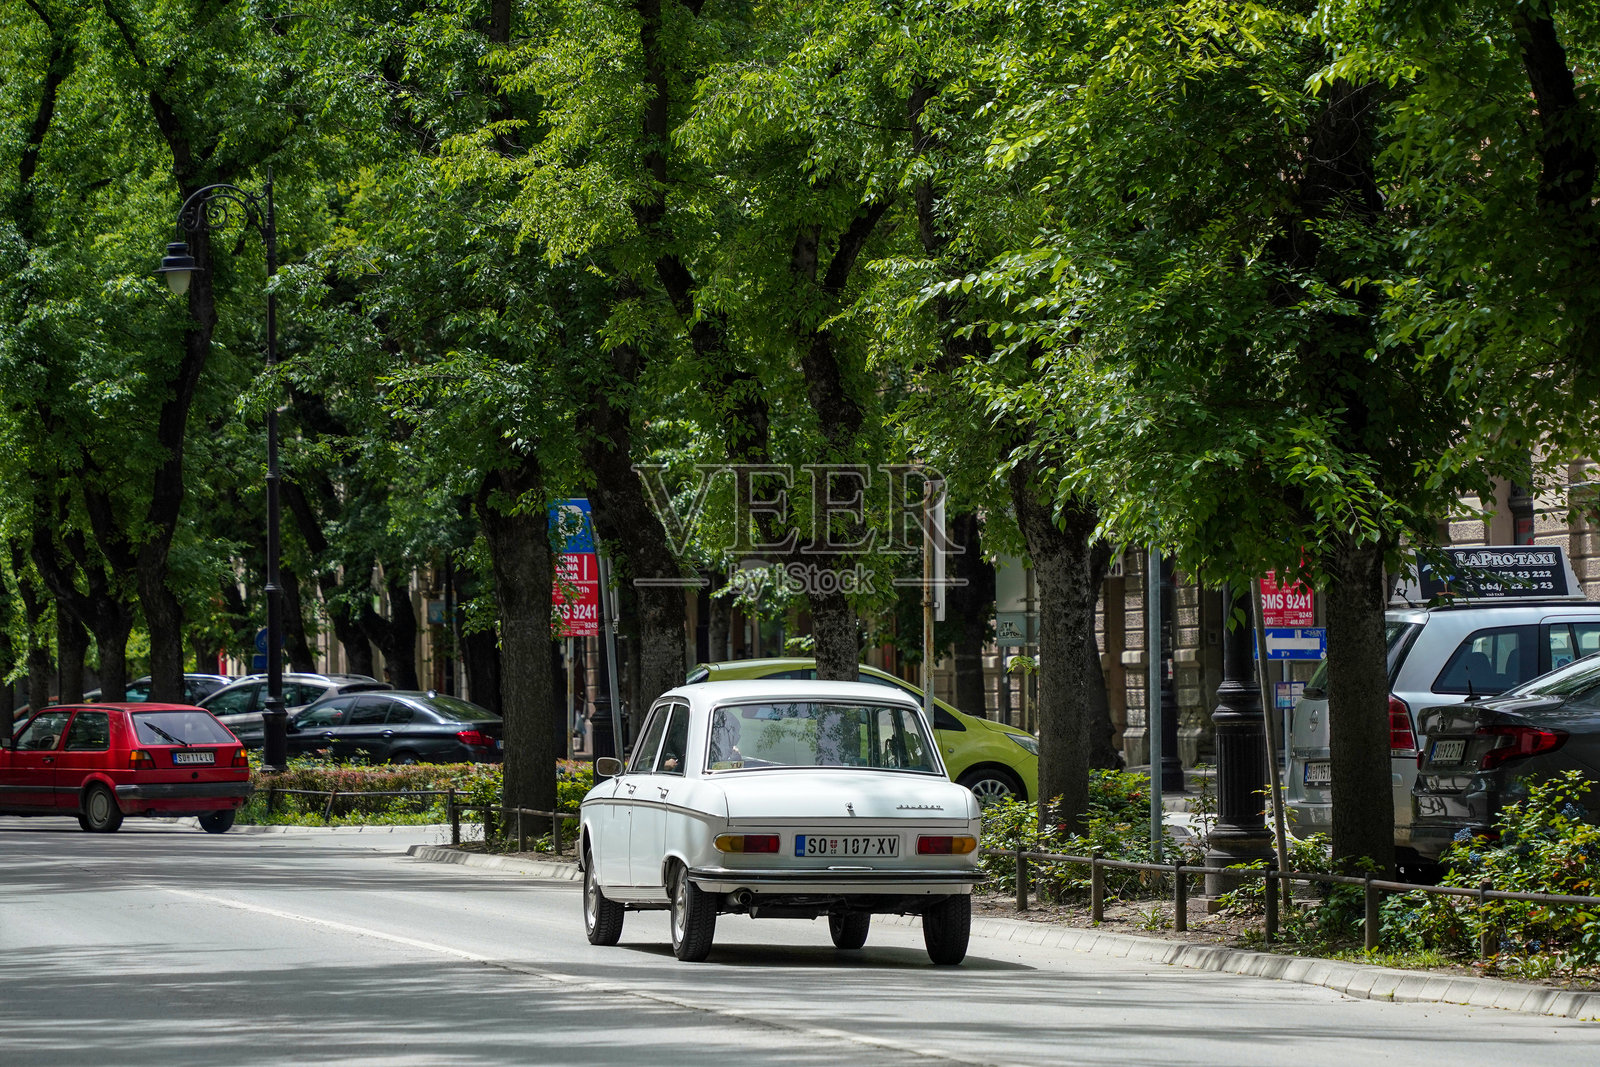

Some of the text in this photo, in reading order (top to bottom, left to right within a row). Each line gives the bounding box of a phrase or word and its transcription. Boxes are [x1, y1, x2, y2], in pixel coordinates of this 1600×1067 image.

[1532, 570, 1552, 578] 222
[1539, 581, 1554, 590] 23
[1261, 594, 1311, 609] SMS 9241
[573, 604, 597, 620] 9241
[808, 837, 827, 854] SO
